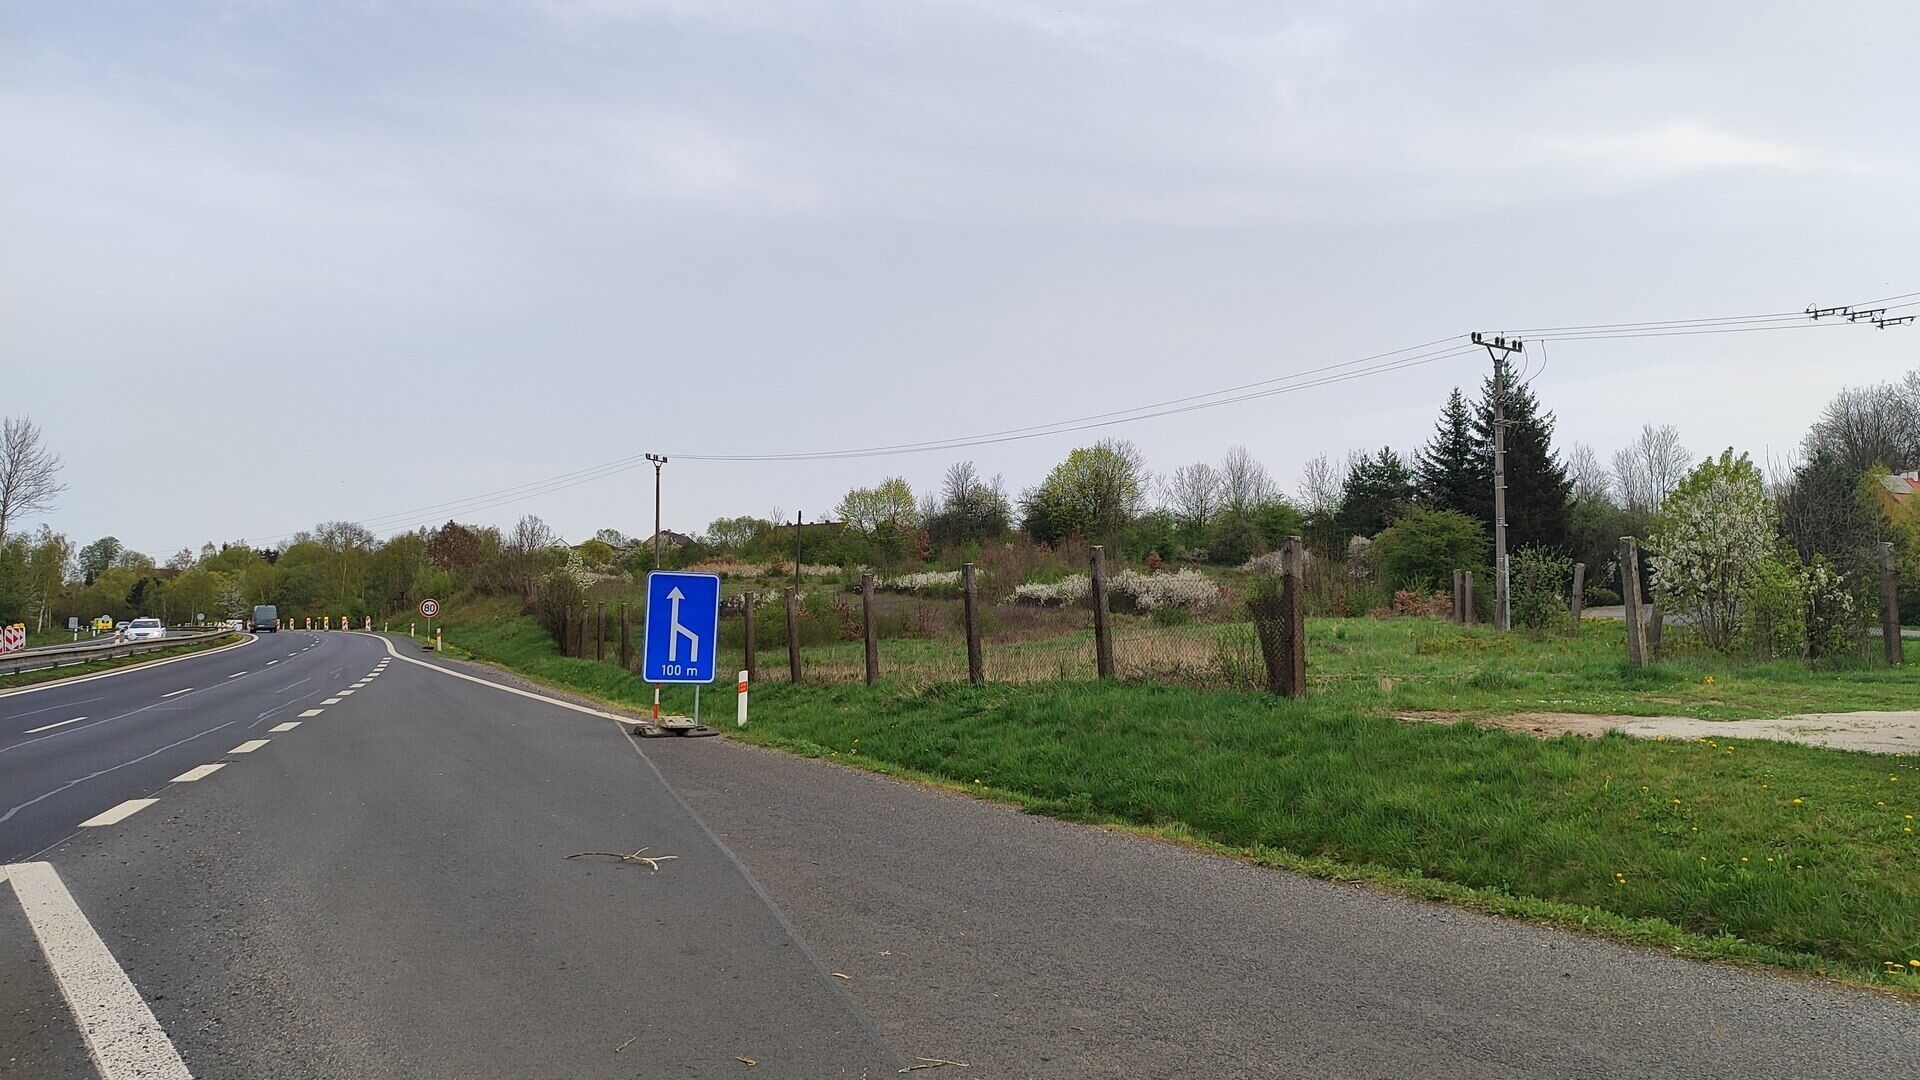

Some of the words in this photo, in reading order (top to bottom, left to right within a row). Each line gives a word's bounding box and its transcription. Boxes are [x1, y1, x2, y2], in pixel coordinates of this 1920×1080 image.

[424, 604, 435, 612] 80
[662, 664, 682, 676] 100
[686, 667, 698, 676] m
